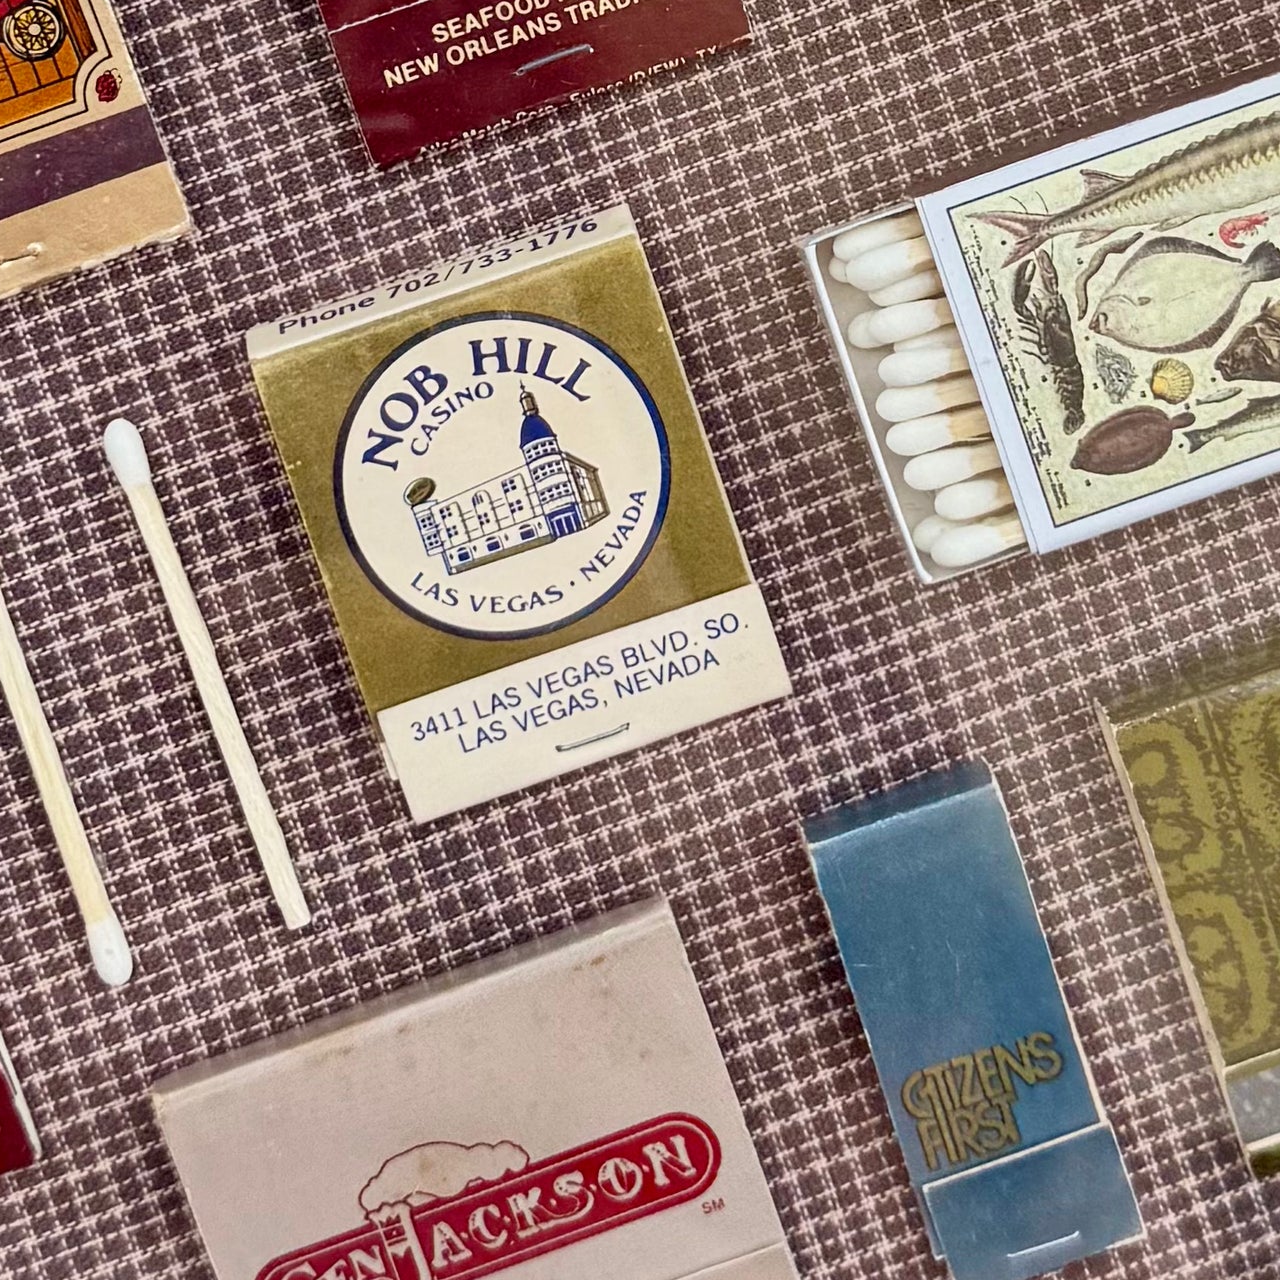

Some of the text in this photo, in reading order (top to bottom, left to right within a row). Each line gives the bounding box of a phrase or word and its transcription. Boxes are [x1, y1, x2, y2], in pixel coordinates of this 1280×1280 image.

[383, 52, 439, 88] NEW
[446, 12, 562, 66] ORLEANS
[279, 220, 598, 335] Phone 702/733-1776
[361, 336, 592, 471] NOB HILL
[411, 381, 494, 456] CASINO
[410, 489, 647, 614] LAS VEGAS NEVADA
[410, 613, 749, 742] 3411 LAS VEGAS BLVD. SO.
[458, 648, 720, 753] LAS VEGAS, NEVADA
[901, 1031, 1063, 1120] CITIZENS
[917, 1097, 1021, 1172] FIRST
[702, 1198, 725, 1214] SM
